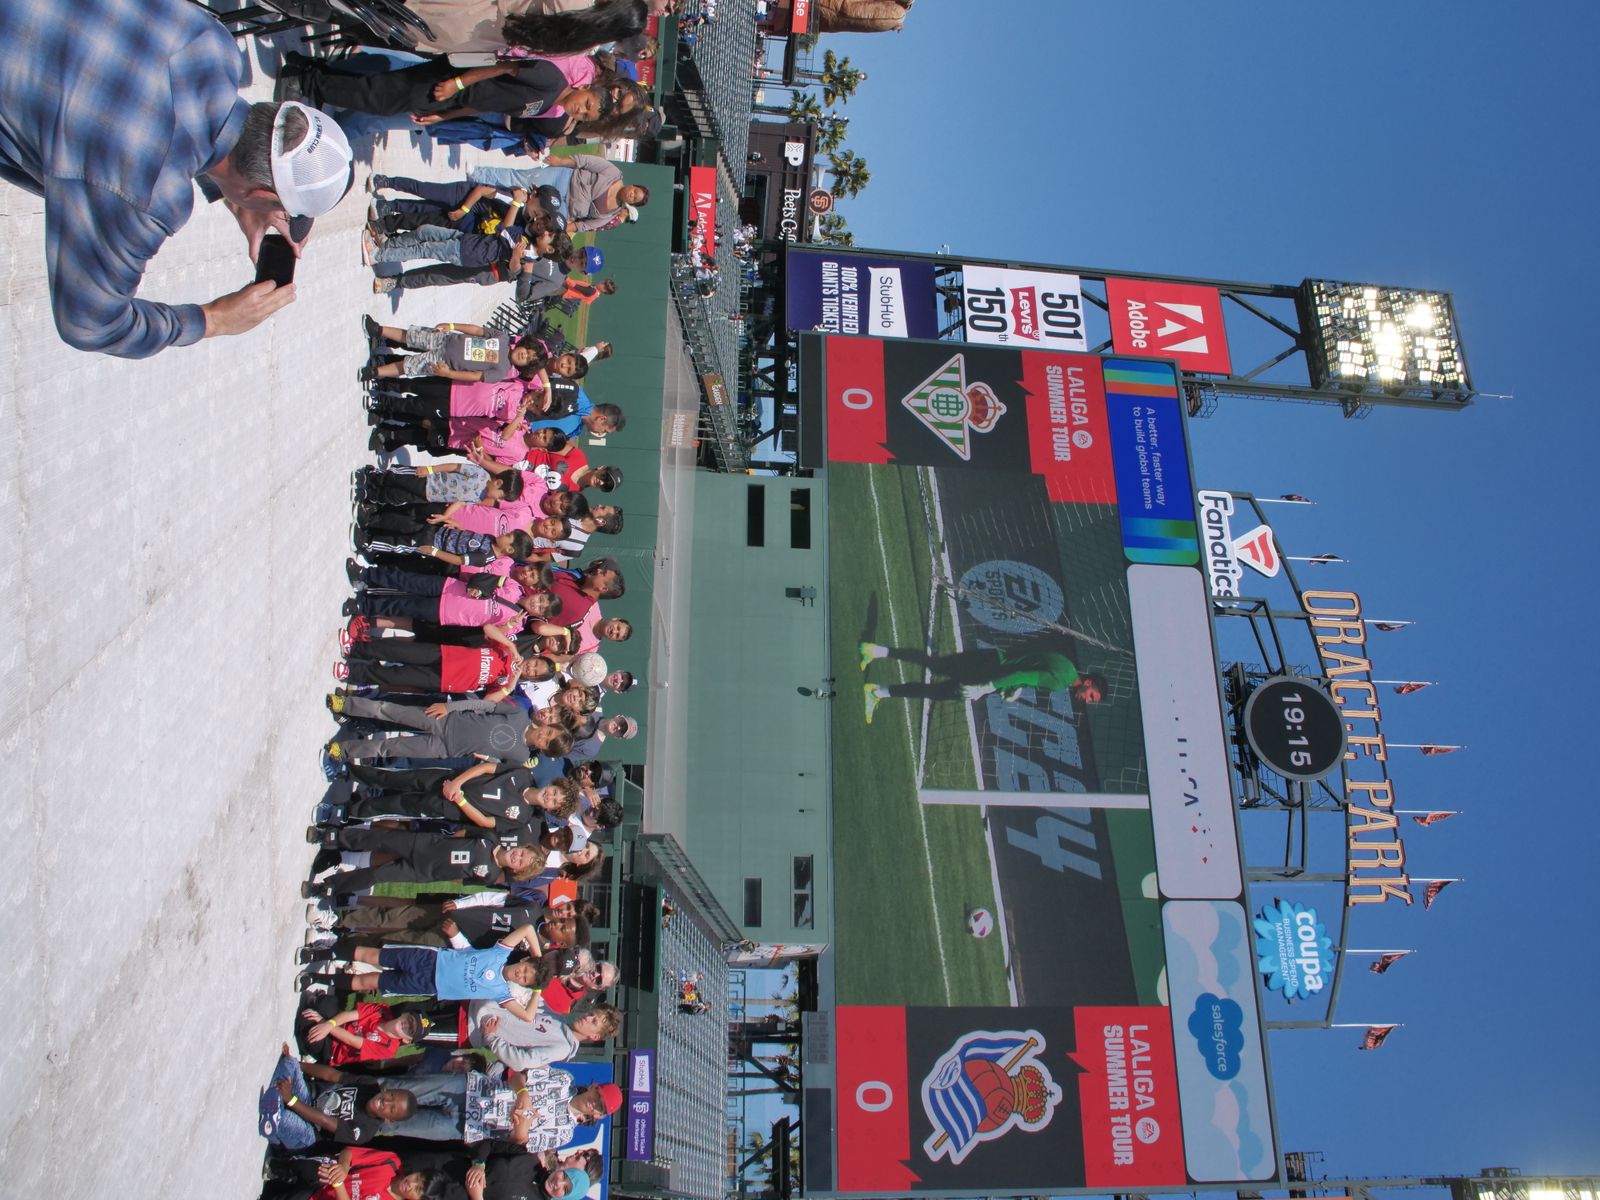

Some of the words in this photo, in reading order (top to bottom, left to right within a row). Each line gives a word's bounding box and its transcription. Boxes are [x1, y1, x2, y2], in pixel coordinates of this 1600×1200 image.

[307, 139, 320, 154] CLUB
[822, 262, 838, 295] GIANTS
[841, 266, 858, 292] 100%
[842, 293, 859, 334] VERIFIED
[880, 275, 895, 329] StubHub
[1040, 292, 1084, 340] 501
[1127, 299, 1151, 349] Adobe
[842, 388, 873, 410] 0
[1045, 365, 1067, 424] SUMMER
[1067, 367, 1089, 426] LALIGA
[1146, 407, 1155, 415] A
[1133, 406, 1142, 417] to
[1051, 426, 1071, 462] TOUR
[1134, 419, 1146, 443] build
[1147, 417, 1158, 450] better,
[1136, 445, 1150, 475] global
[1152, 452, 1163, 482] faster
[1142, 478, 1153, 510] teams
[1155, 484, 1166, 506] way
[1204, 495, 1237, 597] Fanatics
[1282, 693, 1312, 767] 19:15
[1301, 590, 1387, 761] ORACLE
[1345, 779, 1416, 908] PARK
[482, 788, 501, 800] 7
[450, 851, 471, 865] 8
[491, 912, 512, 933] 21
[1283, 918, 1295, 958] BUSINESS
[1275, 922, 1290, 982] MANAGEMENT
[1296, 912, 1323, 991] coupa
[468, 957, 478, 993] ETIHAD
[1288, 958, 1299, 987] SPEND
[1212, 1004, 1227, 1072] salesforce
[638, 1060, 646, 1088] StubHub
[1103, 1024, 1130, 1110] SUMMER
[1129, 1025, 1155, 1111] LALIGA
[339, 1091, 354, 1119] NASA
[856, 1081, 893, 1112] 0
[633, 1119, 641, 1152] Marketplace
[1110, 1113, 1134, 1167] TOUR
